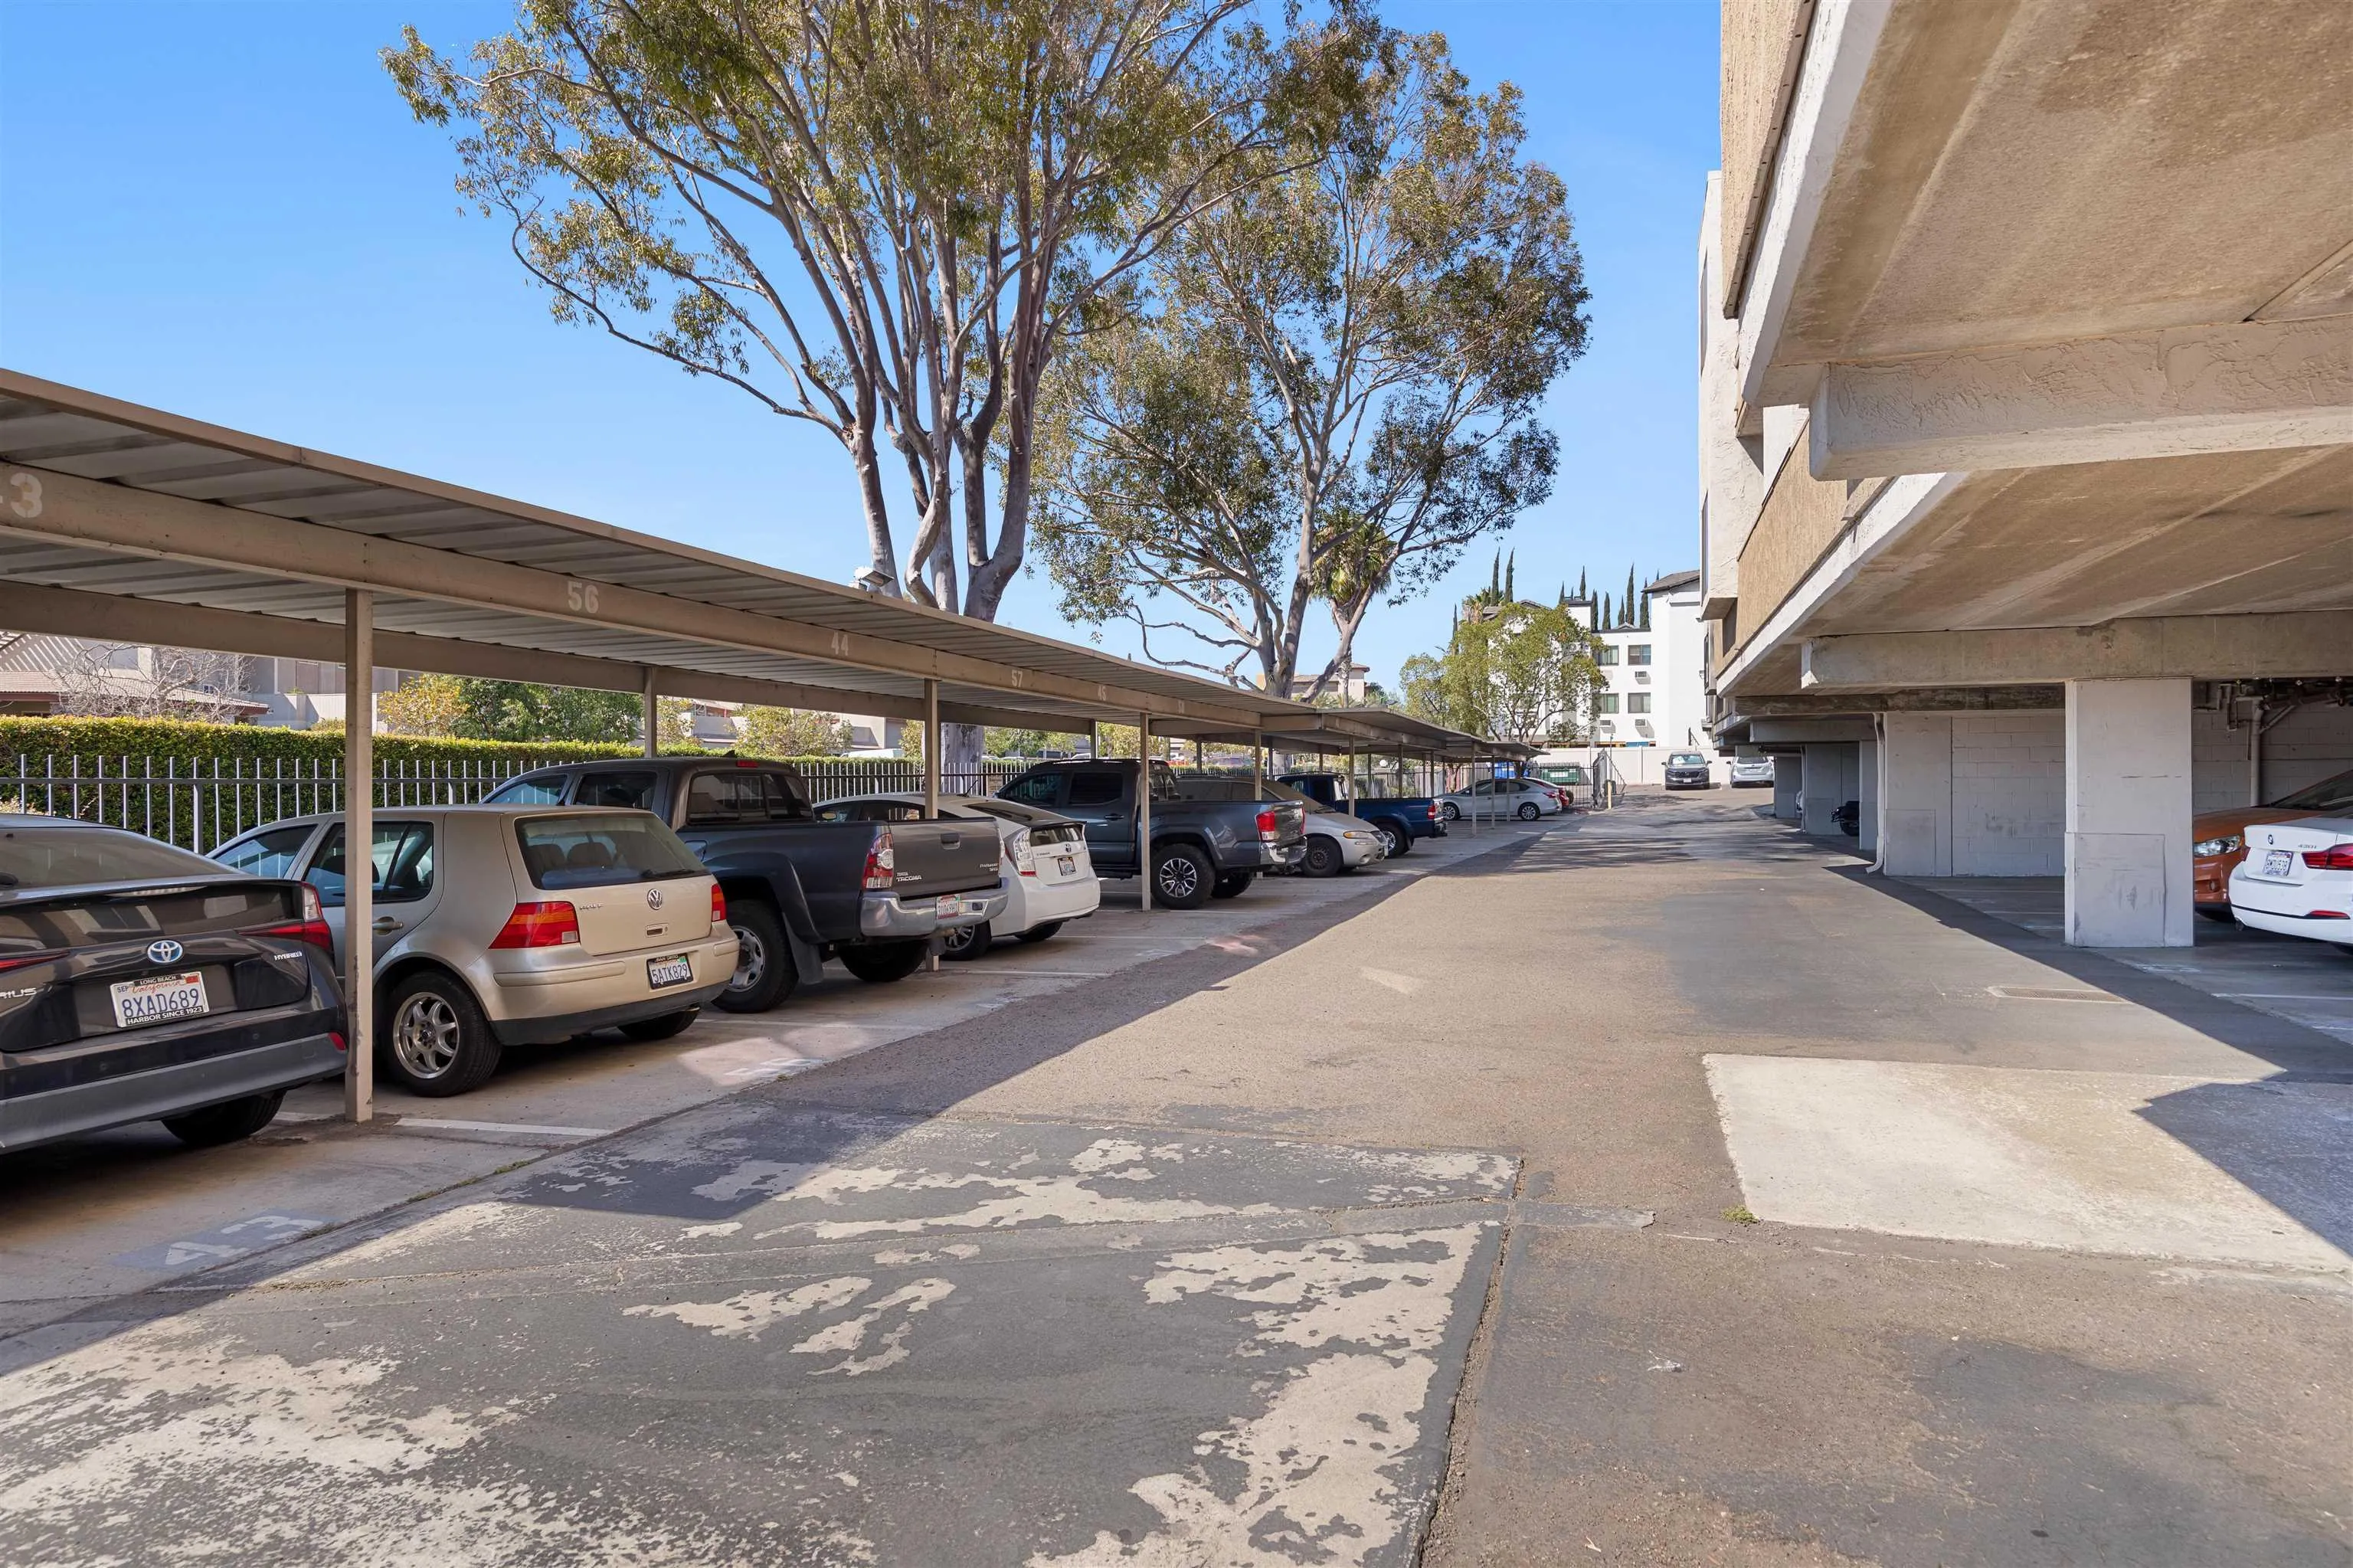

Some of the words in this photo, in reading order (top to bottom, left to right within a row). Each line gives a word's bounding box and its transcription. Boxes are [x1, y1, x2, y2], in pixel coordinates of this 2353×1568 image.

[0, 473, 42, 518] 3
[568, 581, 599, 614] 56
[1012, 669, 1023, 688] 57
[117, 985, 129, 994] SEP
[122, 987, 200, 1019] 8XAD689
[126, 1013, 162, 1025] HARBOR
[162, 1010, 186, 1019] SINCE
[186, 1006, 203, 1015] 1923
